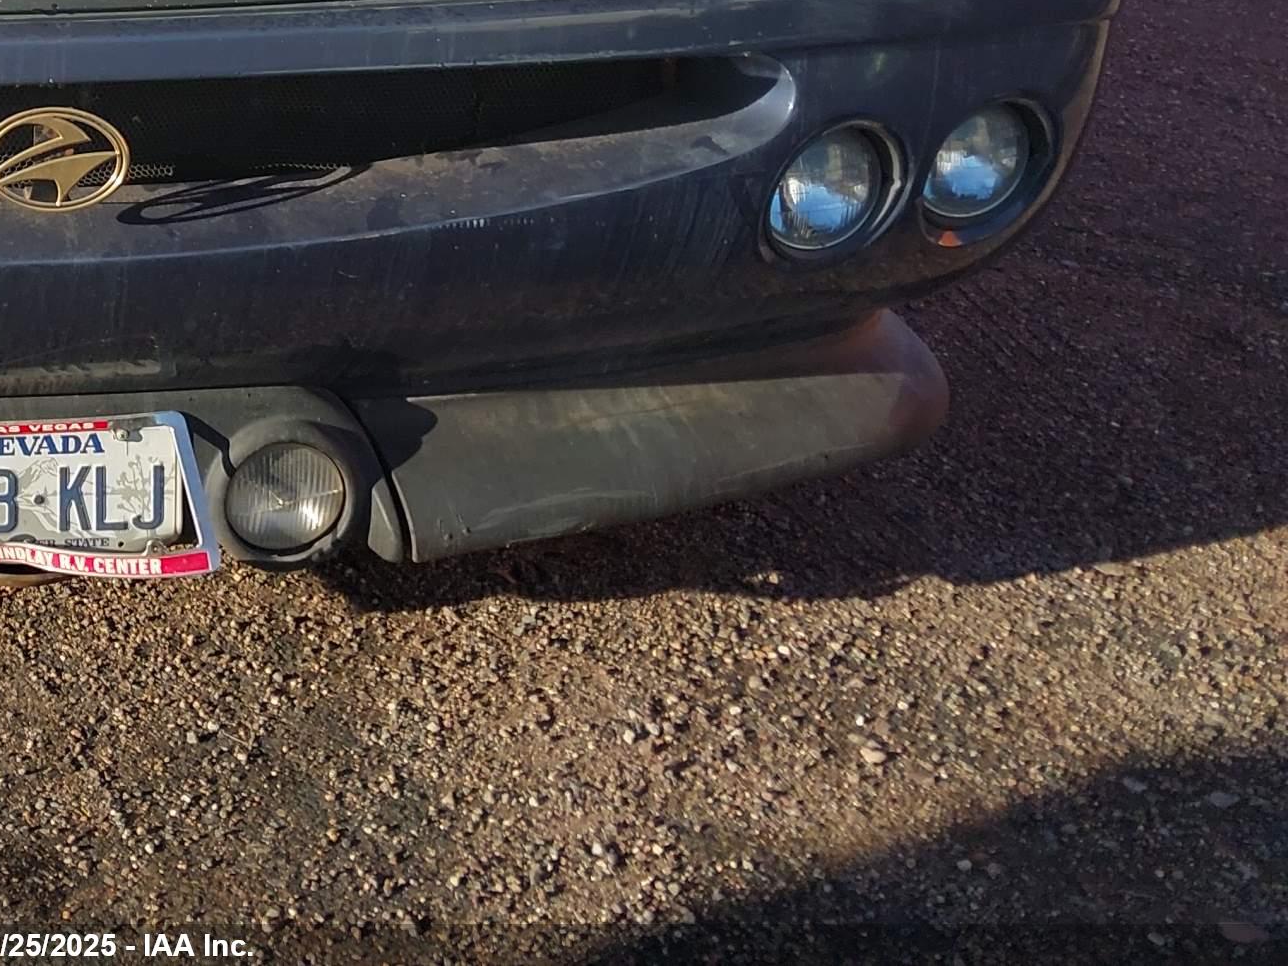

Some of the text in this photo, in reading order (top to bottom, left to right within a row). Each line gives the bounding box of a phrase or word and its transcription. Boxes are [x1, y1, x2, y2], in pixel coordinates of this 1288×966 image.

[28, 422, 94, 433] VEGAS
[59, 465, 165, 532] KLJ
[64, 537, 110, 547] STATE
[60, 553, 89, 572] R.V.
[93, 558, 162, 575] CENTER
